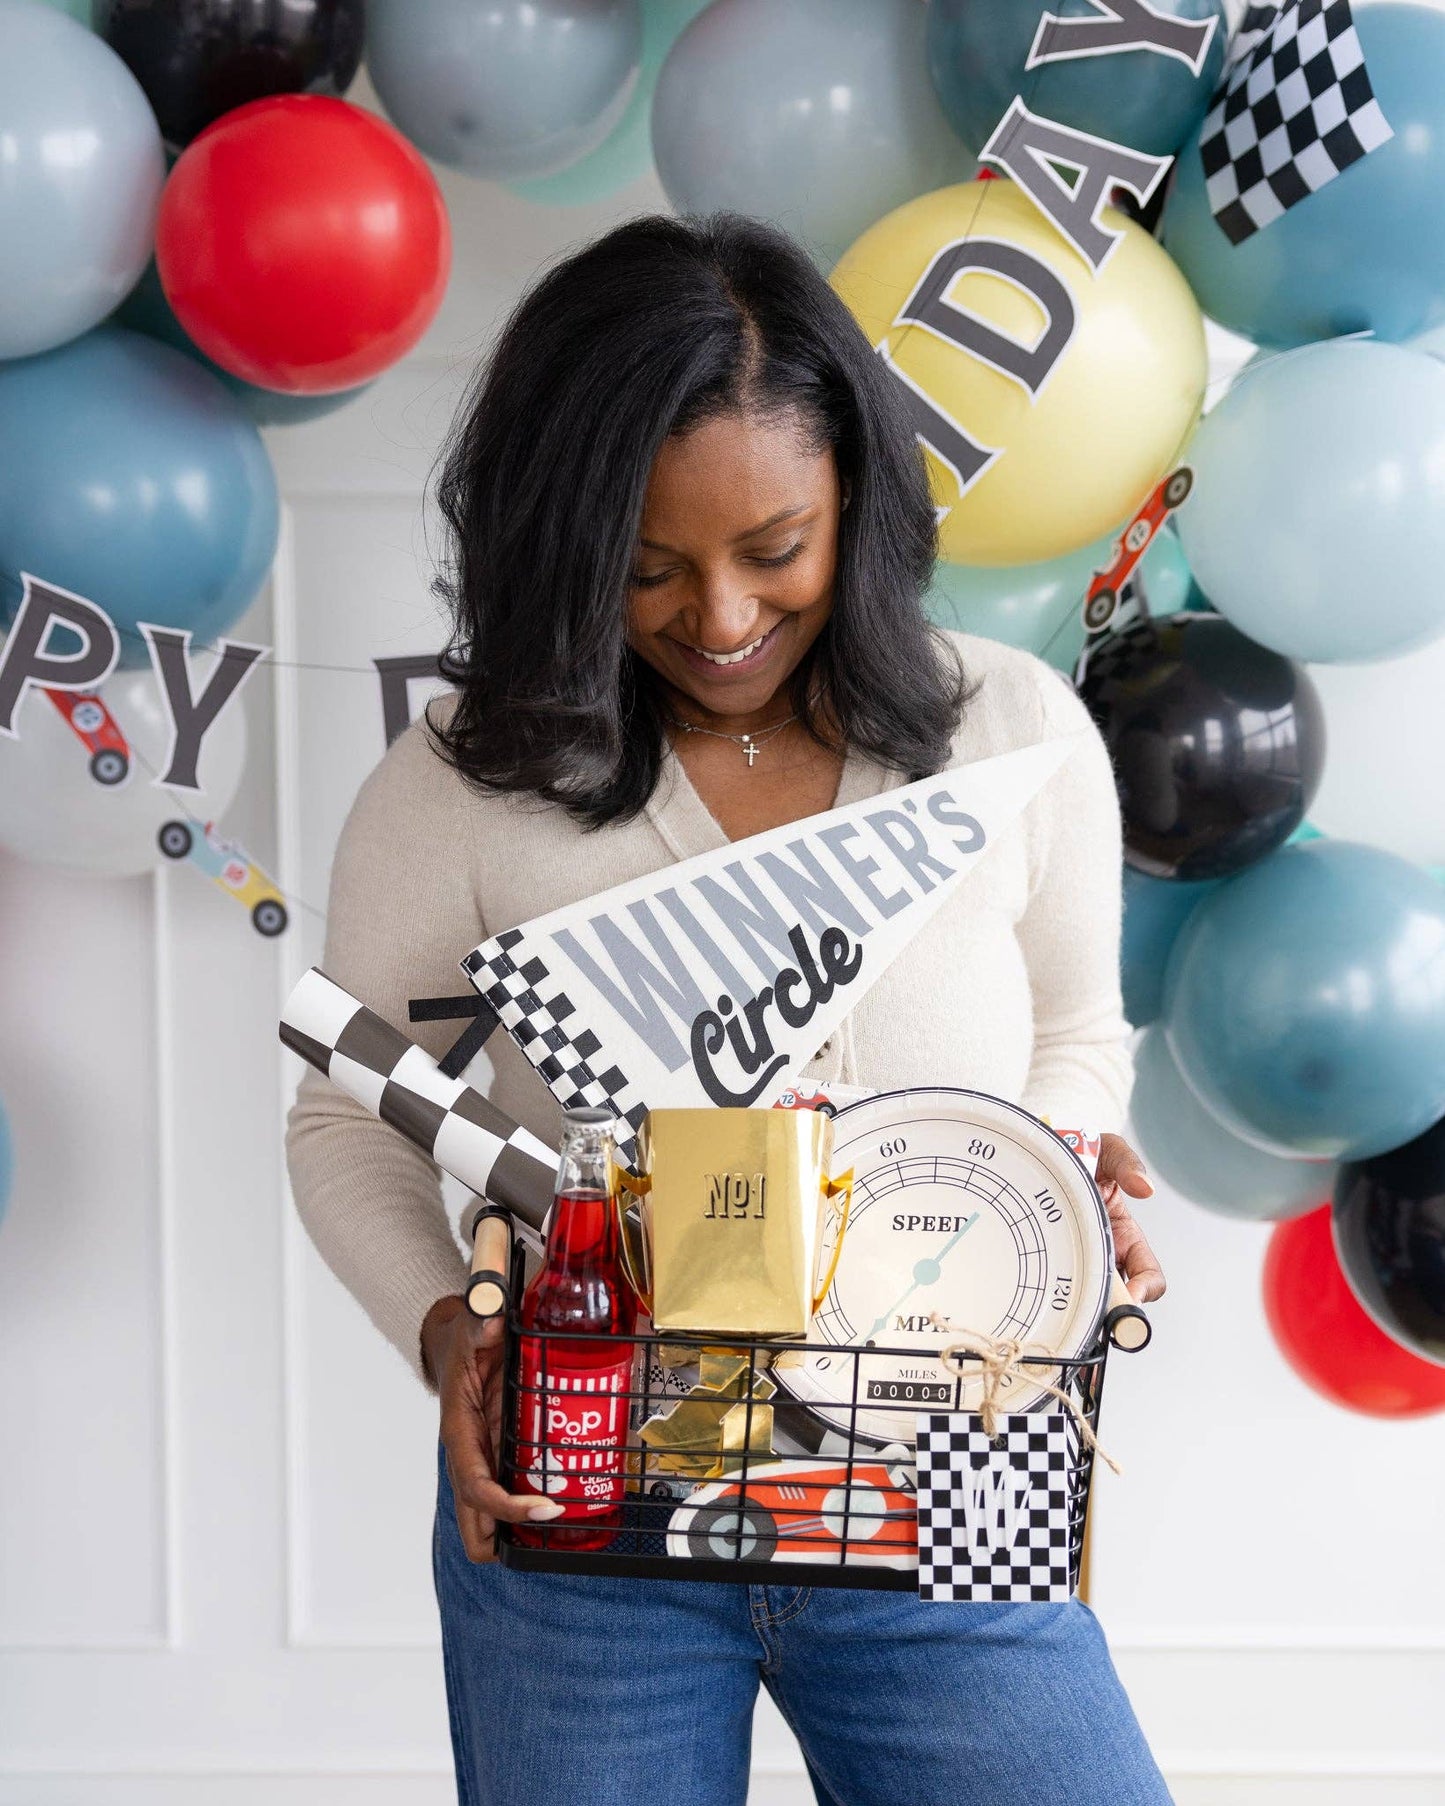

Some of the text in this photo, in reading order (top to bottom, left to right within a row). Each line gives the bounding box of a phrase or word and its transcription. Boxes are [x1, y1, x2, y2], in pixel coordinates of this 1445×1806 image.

[550, 790, 987, 1074] WINNER'S
[690, 923, 863, 1108] Circle
[781, 1094, 794, 1105] 72
[879, 1137, 907, 1158] 60
[967, 1138, 996, 1161] 80
[1034, 1187, 1064, 1224] 100
[1051, 1275, 1073, 1311] 120
[898, 1368, 938, 1380] MILES
[584, 1481, 614, 1497] SODA
